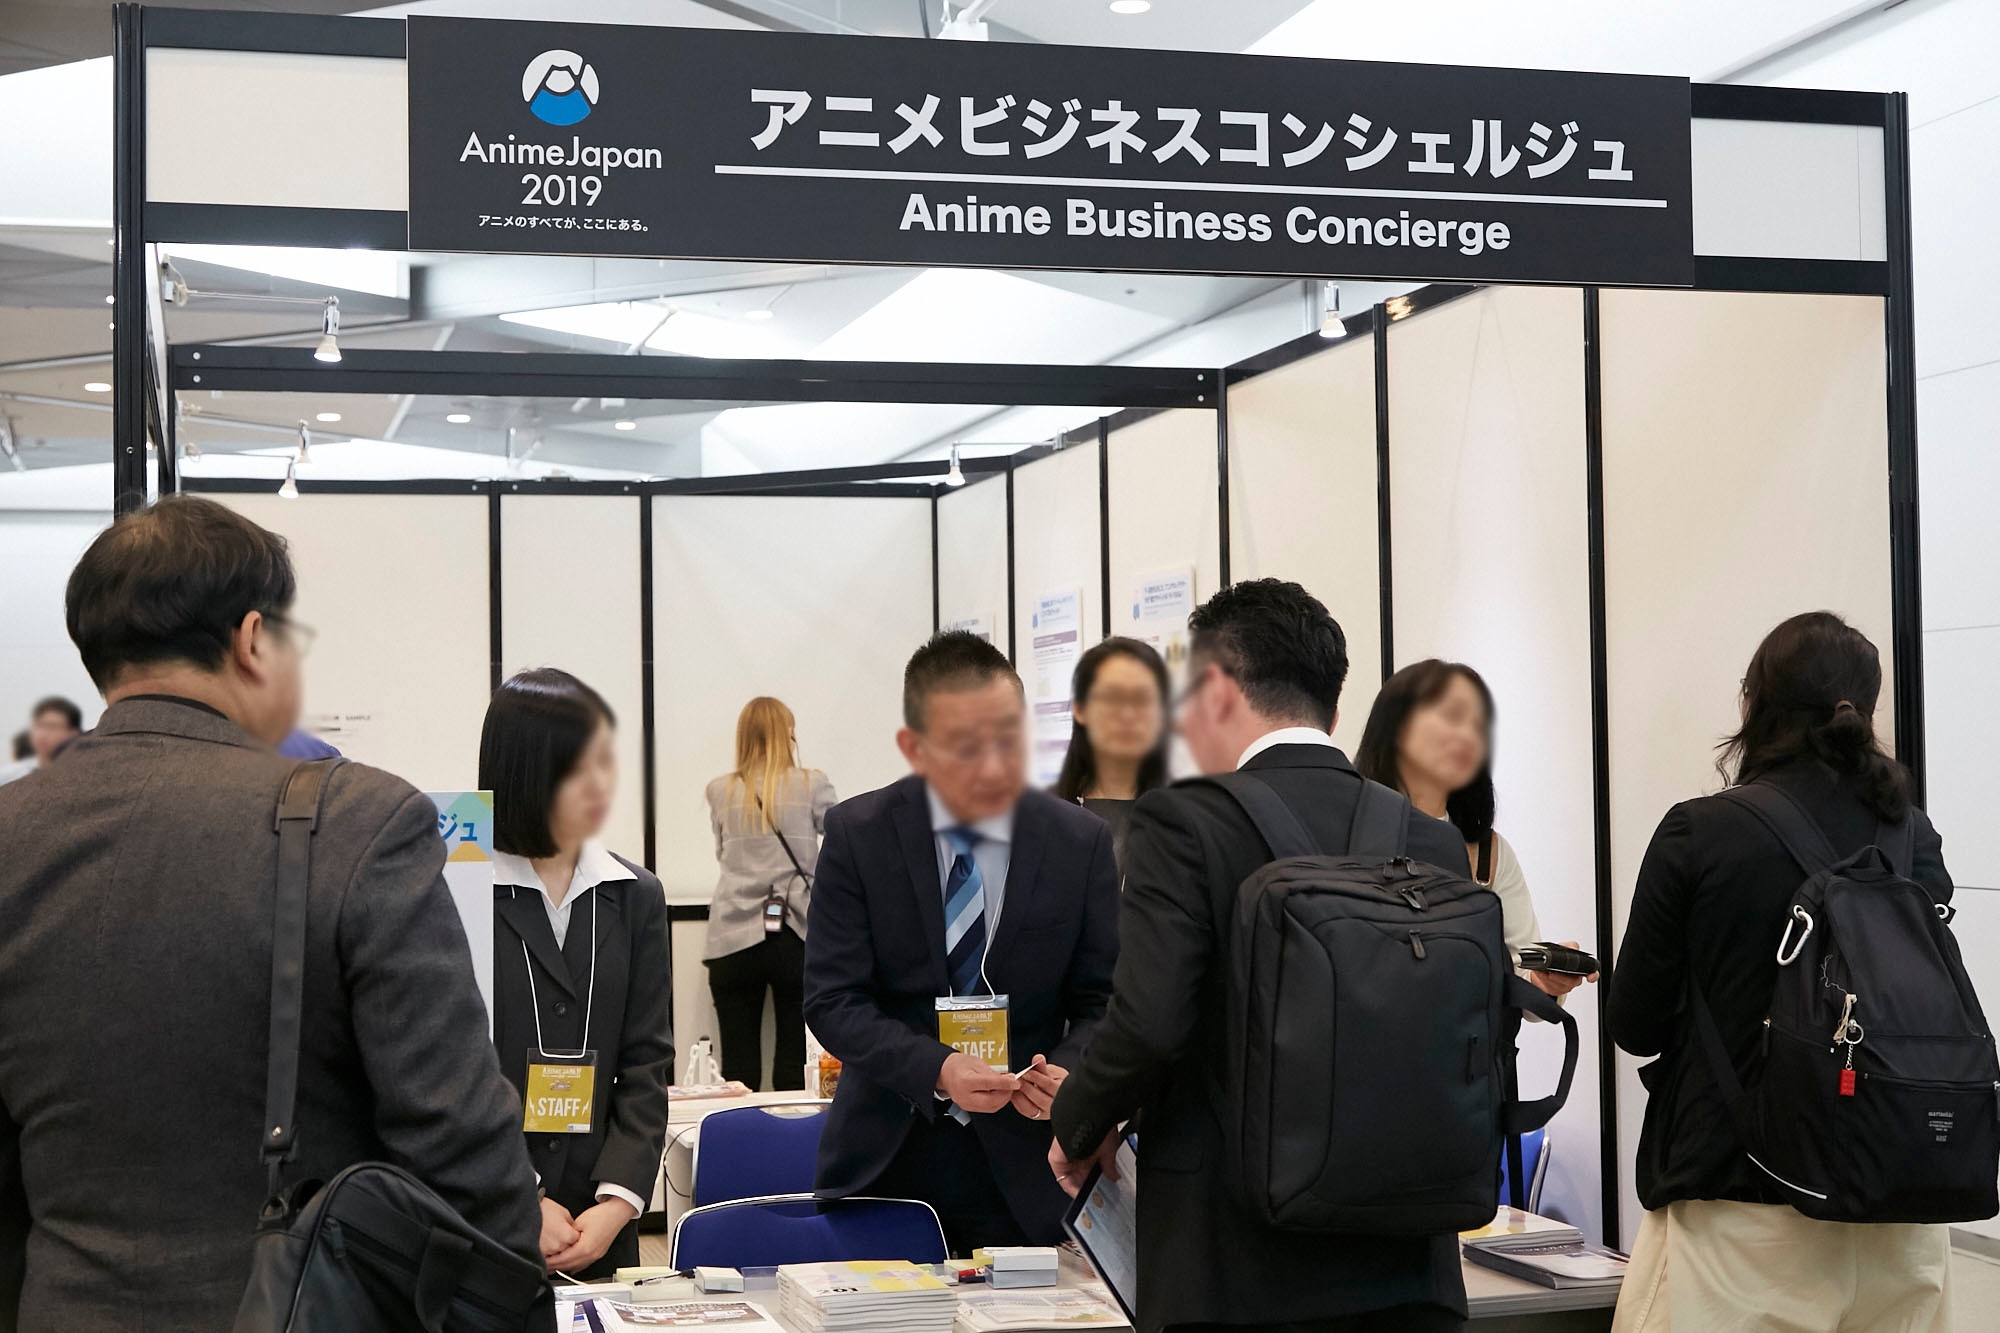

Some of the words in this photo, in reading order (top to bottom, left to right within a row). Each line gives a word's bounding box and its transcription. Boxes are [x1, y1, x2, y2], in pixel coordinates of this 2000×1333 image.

[460, 131, 662, 177] AnimeJapan
[751, 89, 1633, 181] アニメビジネスコンシェルジュ
[521, 174, 603, 206] 2019
[478, 214, 649, 232] アニメのすべてが、ここにある。
[900, 193, 1052, 236] Anime
[1067, 198, 1272, 242] Business
[1286, 206, 1511, 256] Concierge
[538, 1098, 581, 1117] STAFF
